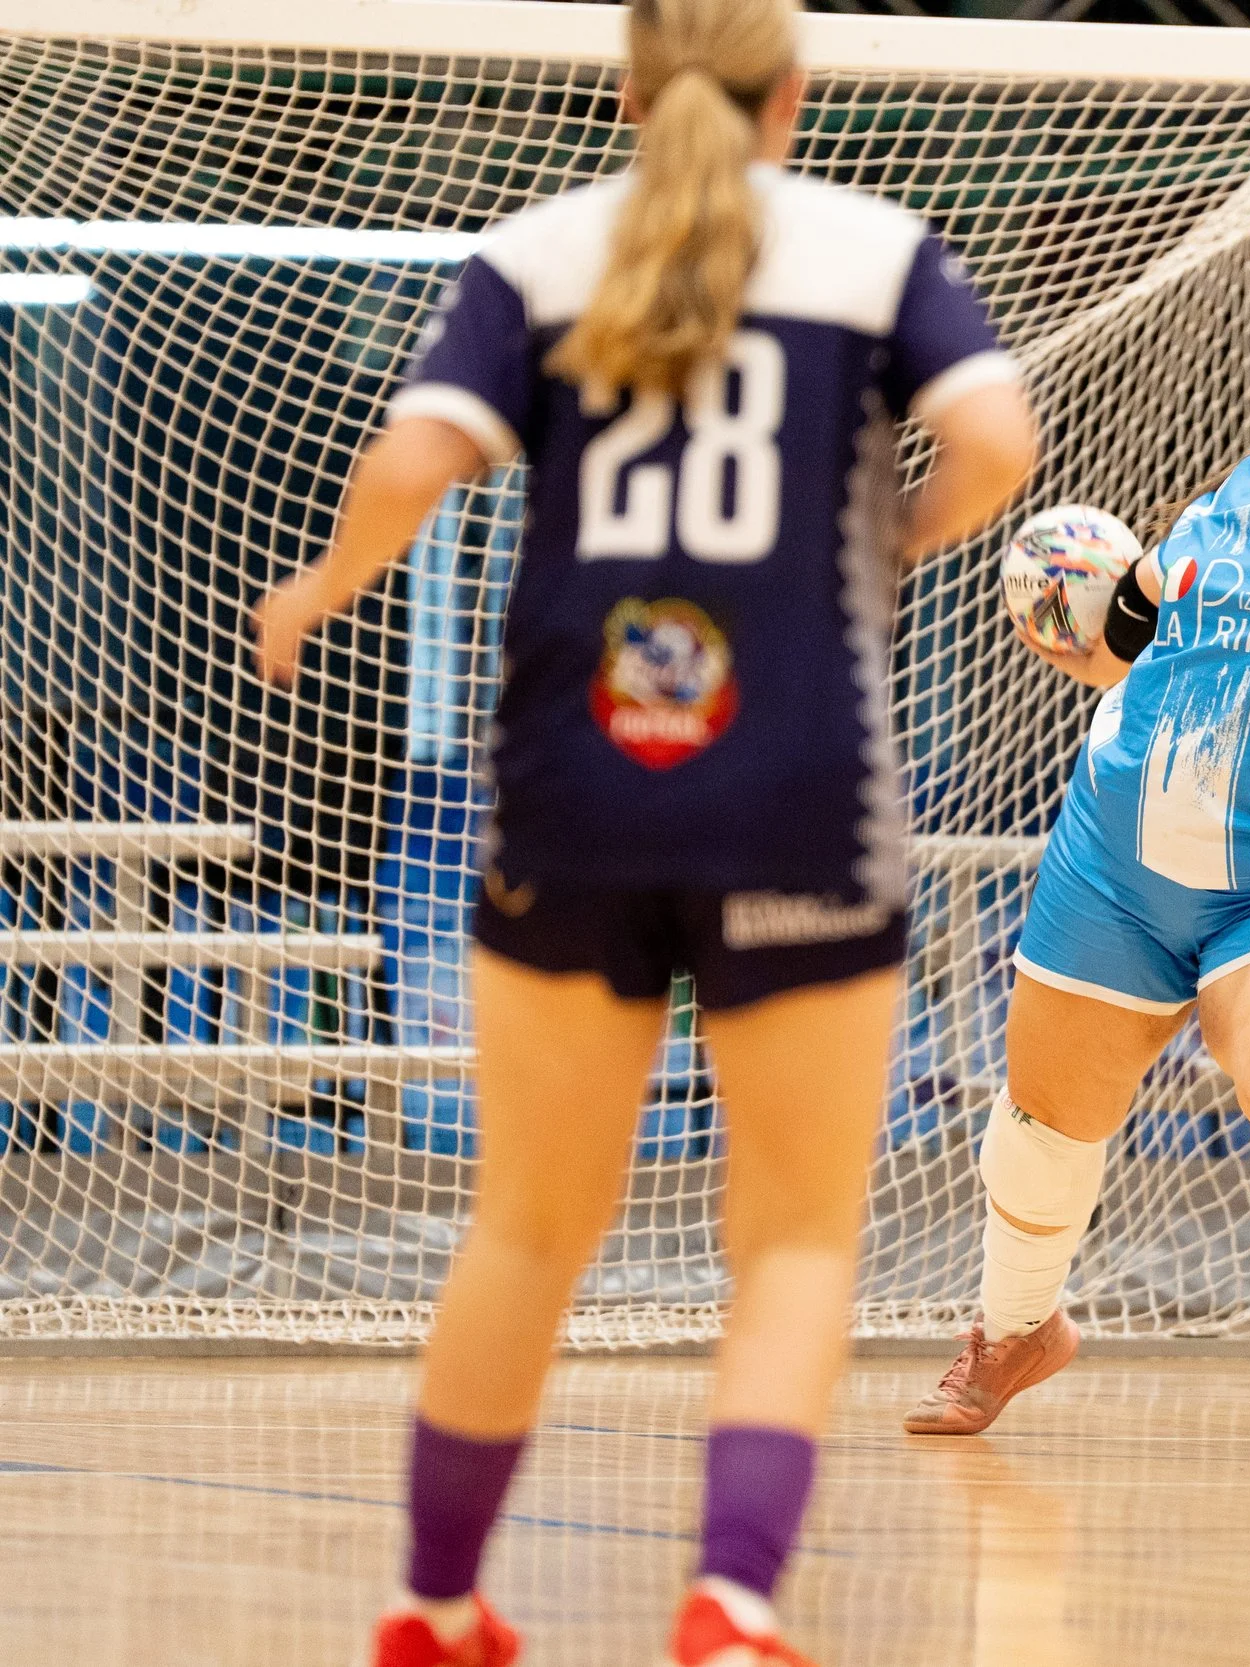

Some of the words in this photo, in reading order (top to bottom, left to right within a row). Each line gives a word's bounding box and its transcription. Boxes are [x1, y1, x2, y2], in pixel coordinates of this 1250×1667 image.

[576, 329, 787, 564] 28
[1006, 572, 1050, 590] mitre
[1153, 611, 1184, 648] LA
